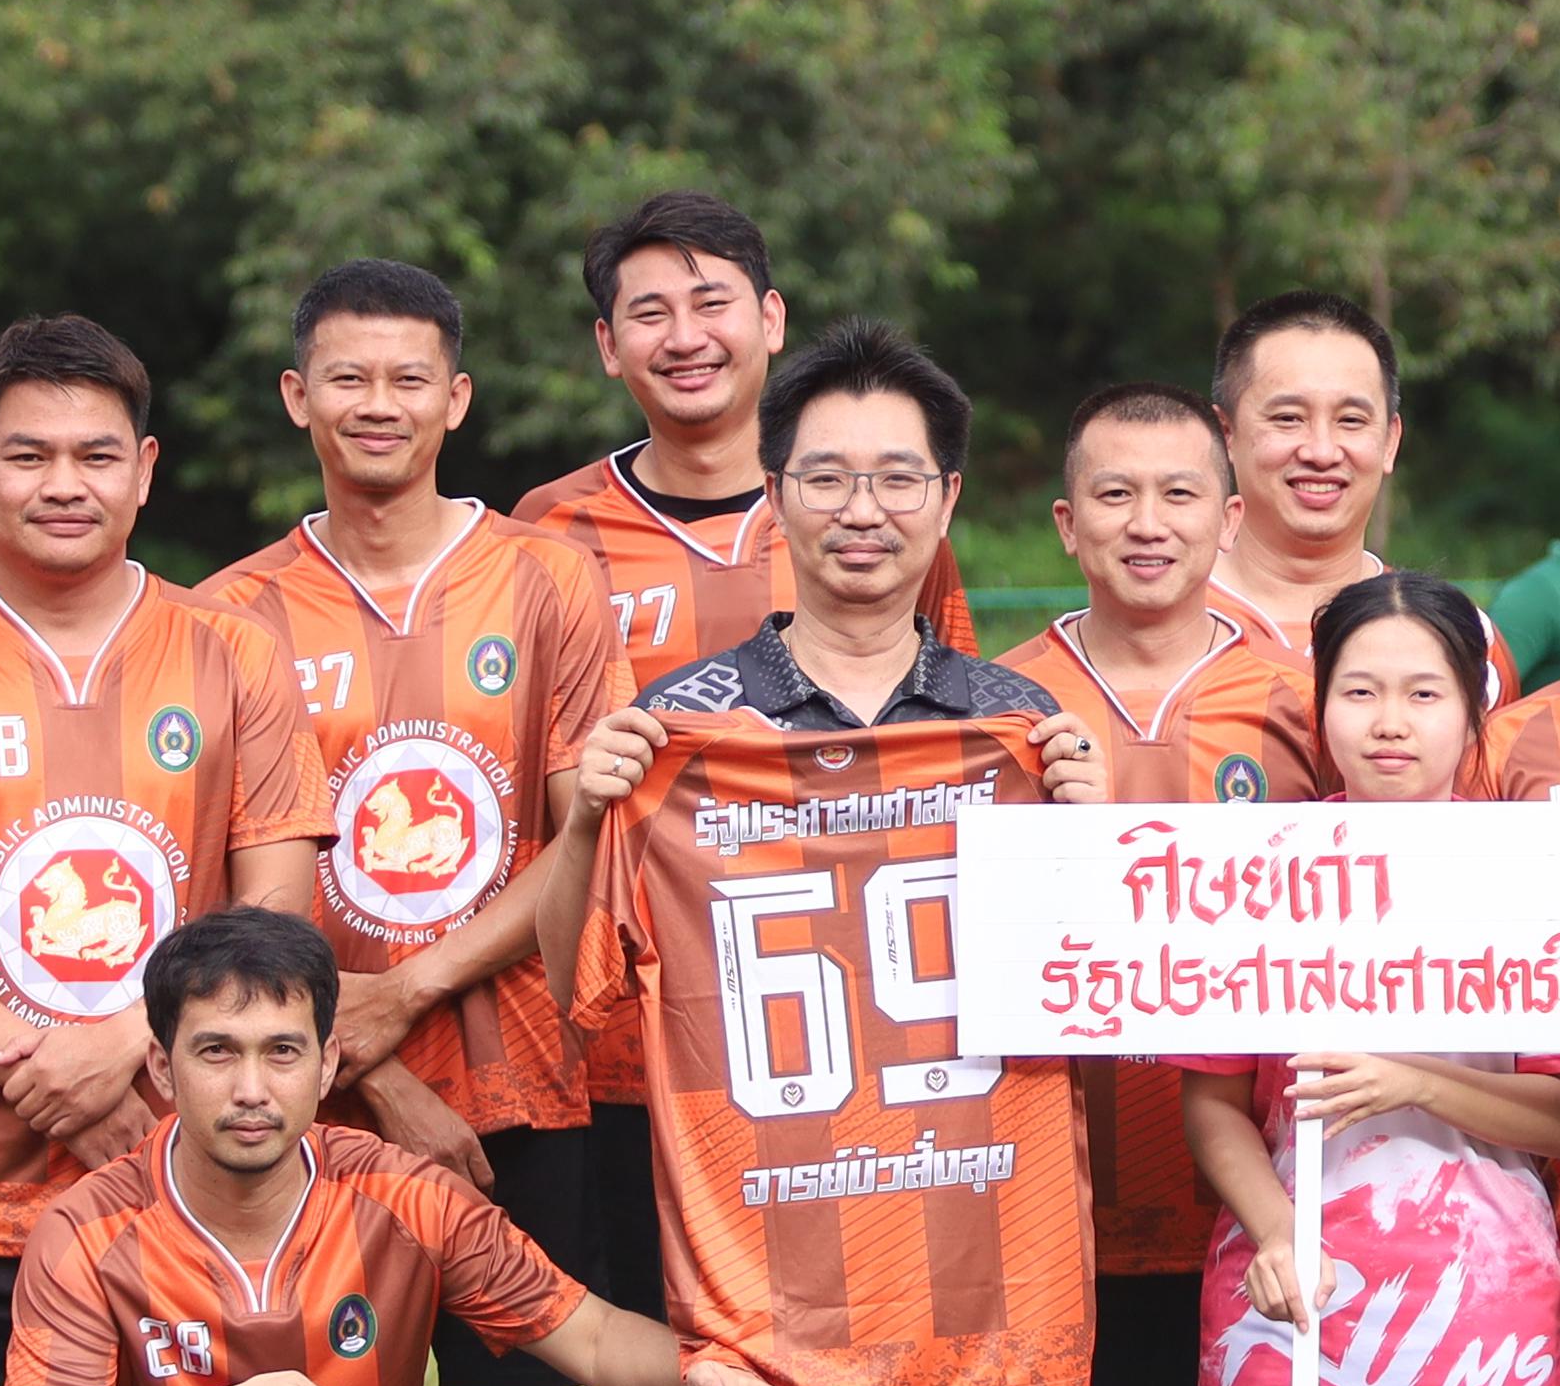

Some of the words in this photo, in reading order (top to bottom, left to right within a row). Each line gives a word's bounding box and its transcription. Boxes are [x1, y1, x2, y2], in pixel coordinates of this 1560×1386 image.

[365, 719, 516, 799] ADMINISTRATION
[33, 795, 190, 883] ADMINISTRATION
[1117, 820, 1394, 925] ศิษย์เก่า
[342, 910, 438, 945] KAMPHAENG
[138, 1316, 214, 1379] 28
